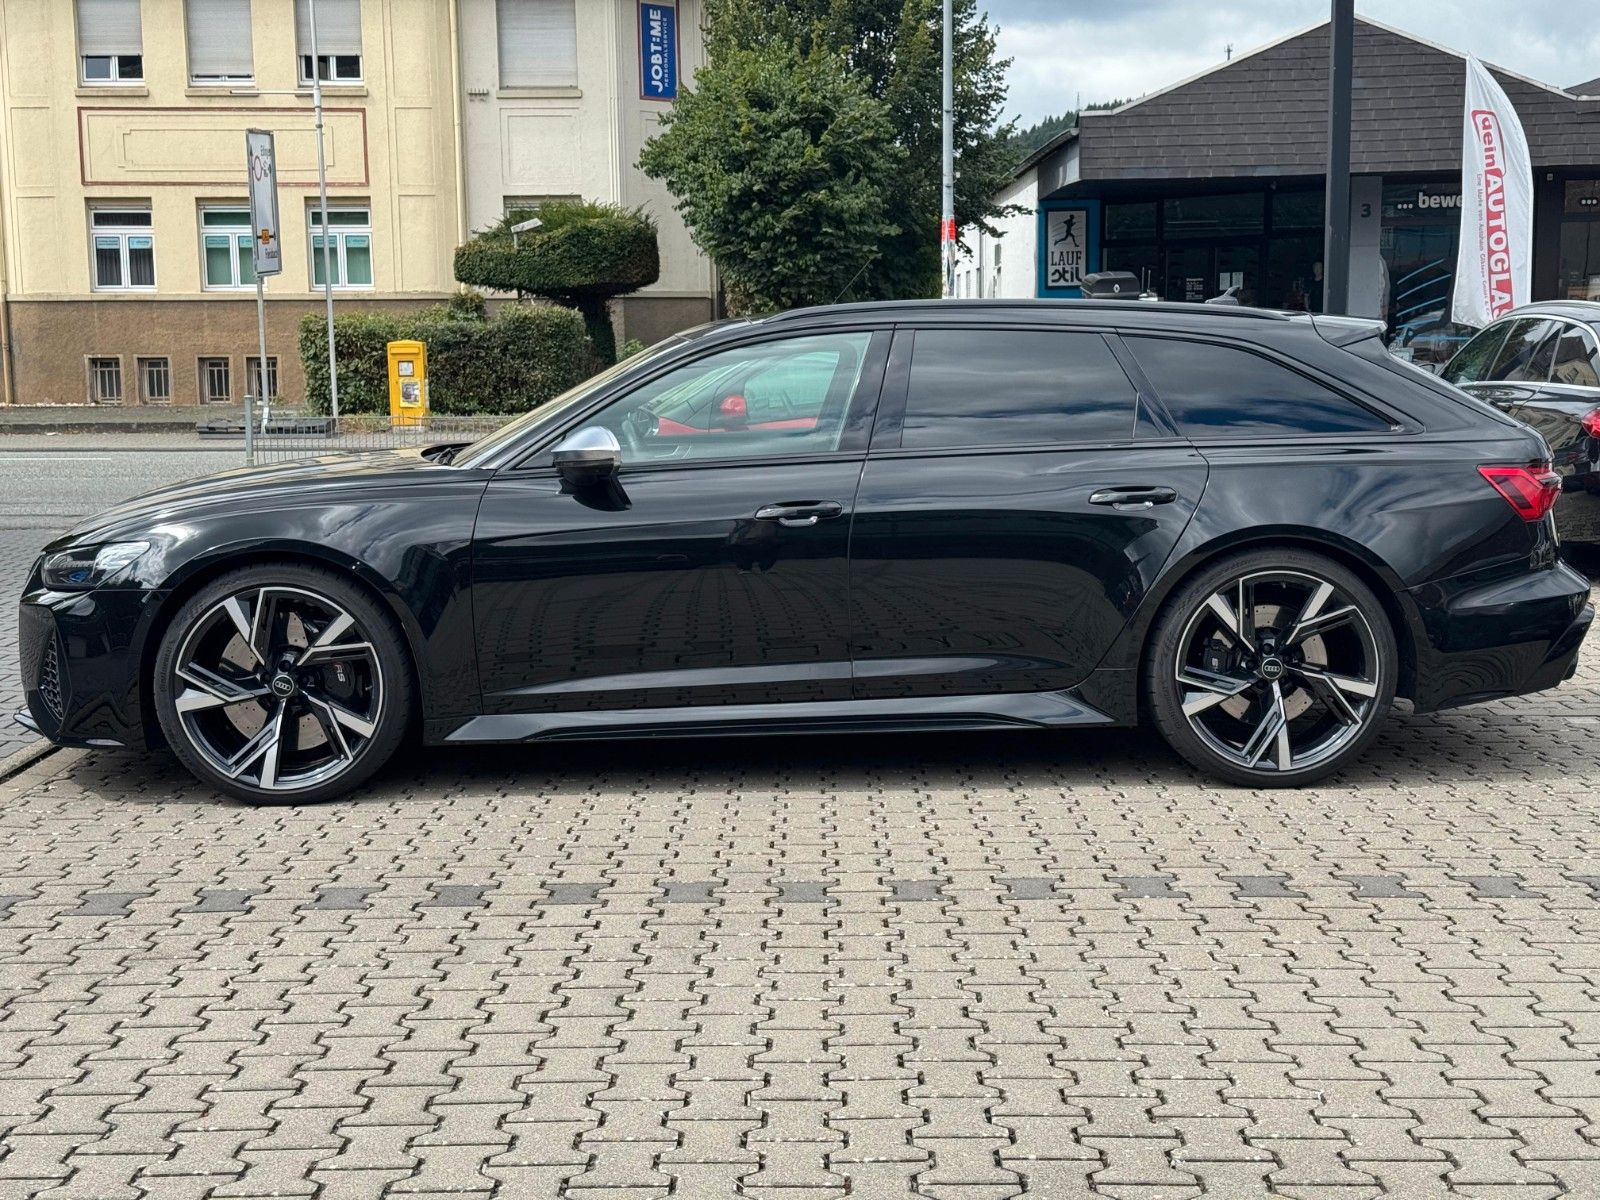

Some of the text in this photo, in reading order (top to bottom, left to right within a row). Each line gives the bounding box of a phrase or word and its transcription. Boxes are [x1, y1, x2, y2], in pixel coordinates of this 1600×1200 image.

[649, 9, 663, 93] JOBT:ME
[1361, 203, 1371, 218] 3
[1051, 251, 1082, 266] LAUF
